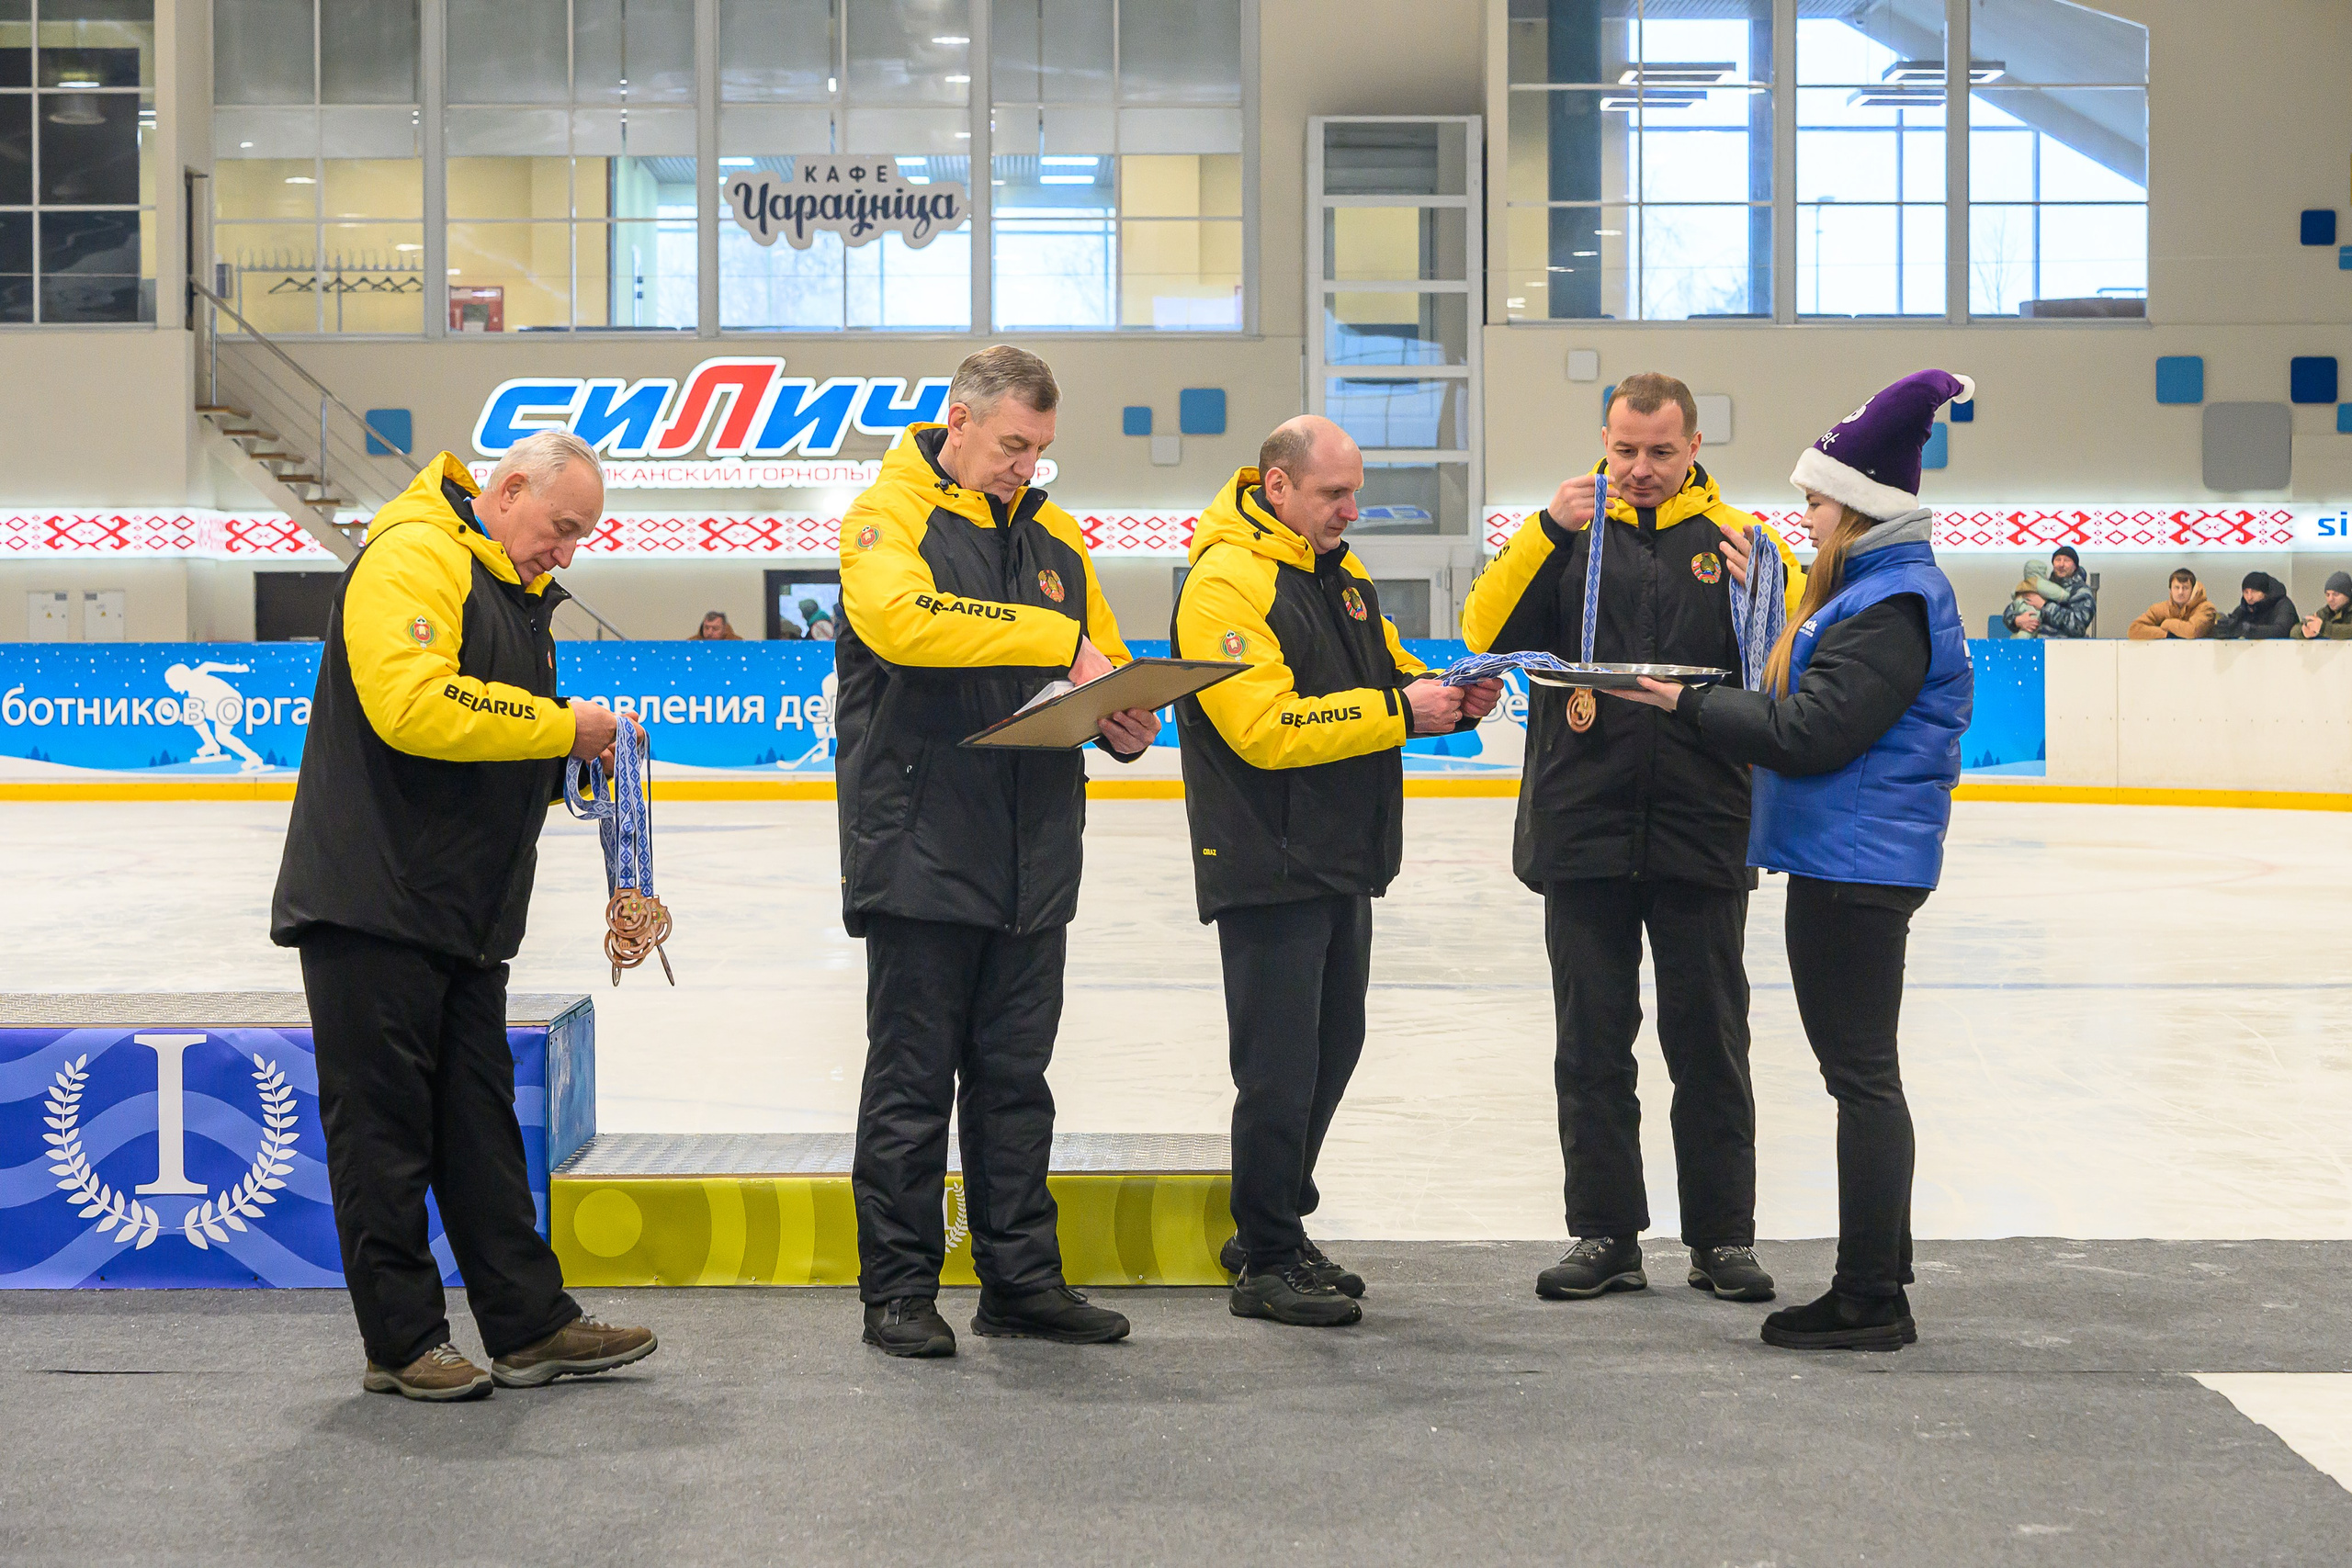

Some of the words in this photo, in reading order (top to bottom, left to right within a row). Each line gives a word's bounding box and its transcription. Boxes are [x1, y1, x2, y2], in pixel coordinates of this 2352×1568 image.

[804, 164, 888, 184] КАФЕ
[733, 182, 960, 240] Чараўніца
[478, 363, 951, 451] СИЛИЧ
[443, 683, 537, 720] BELARUS
[562, 694, 765, 725] вления
